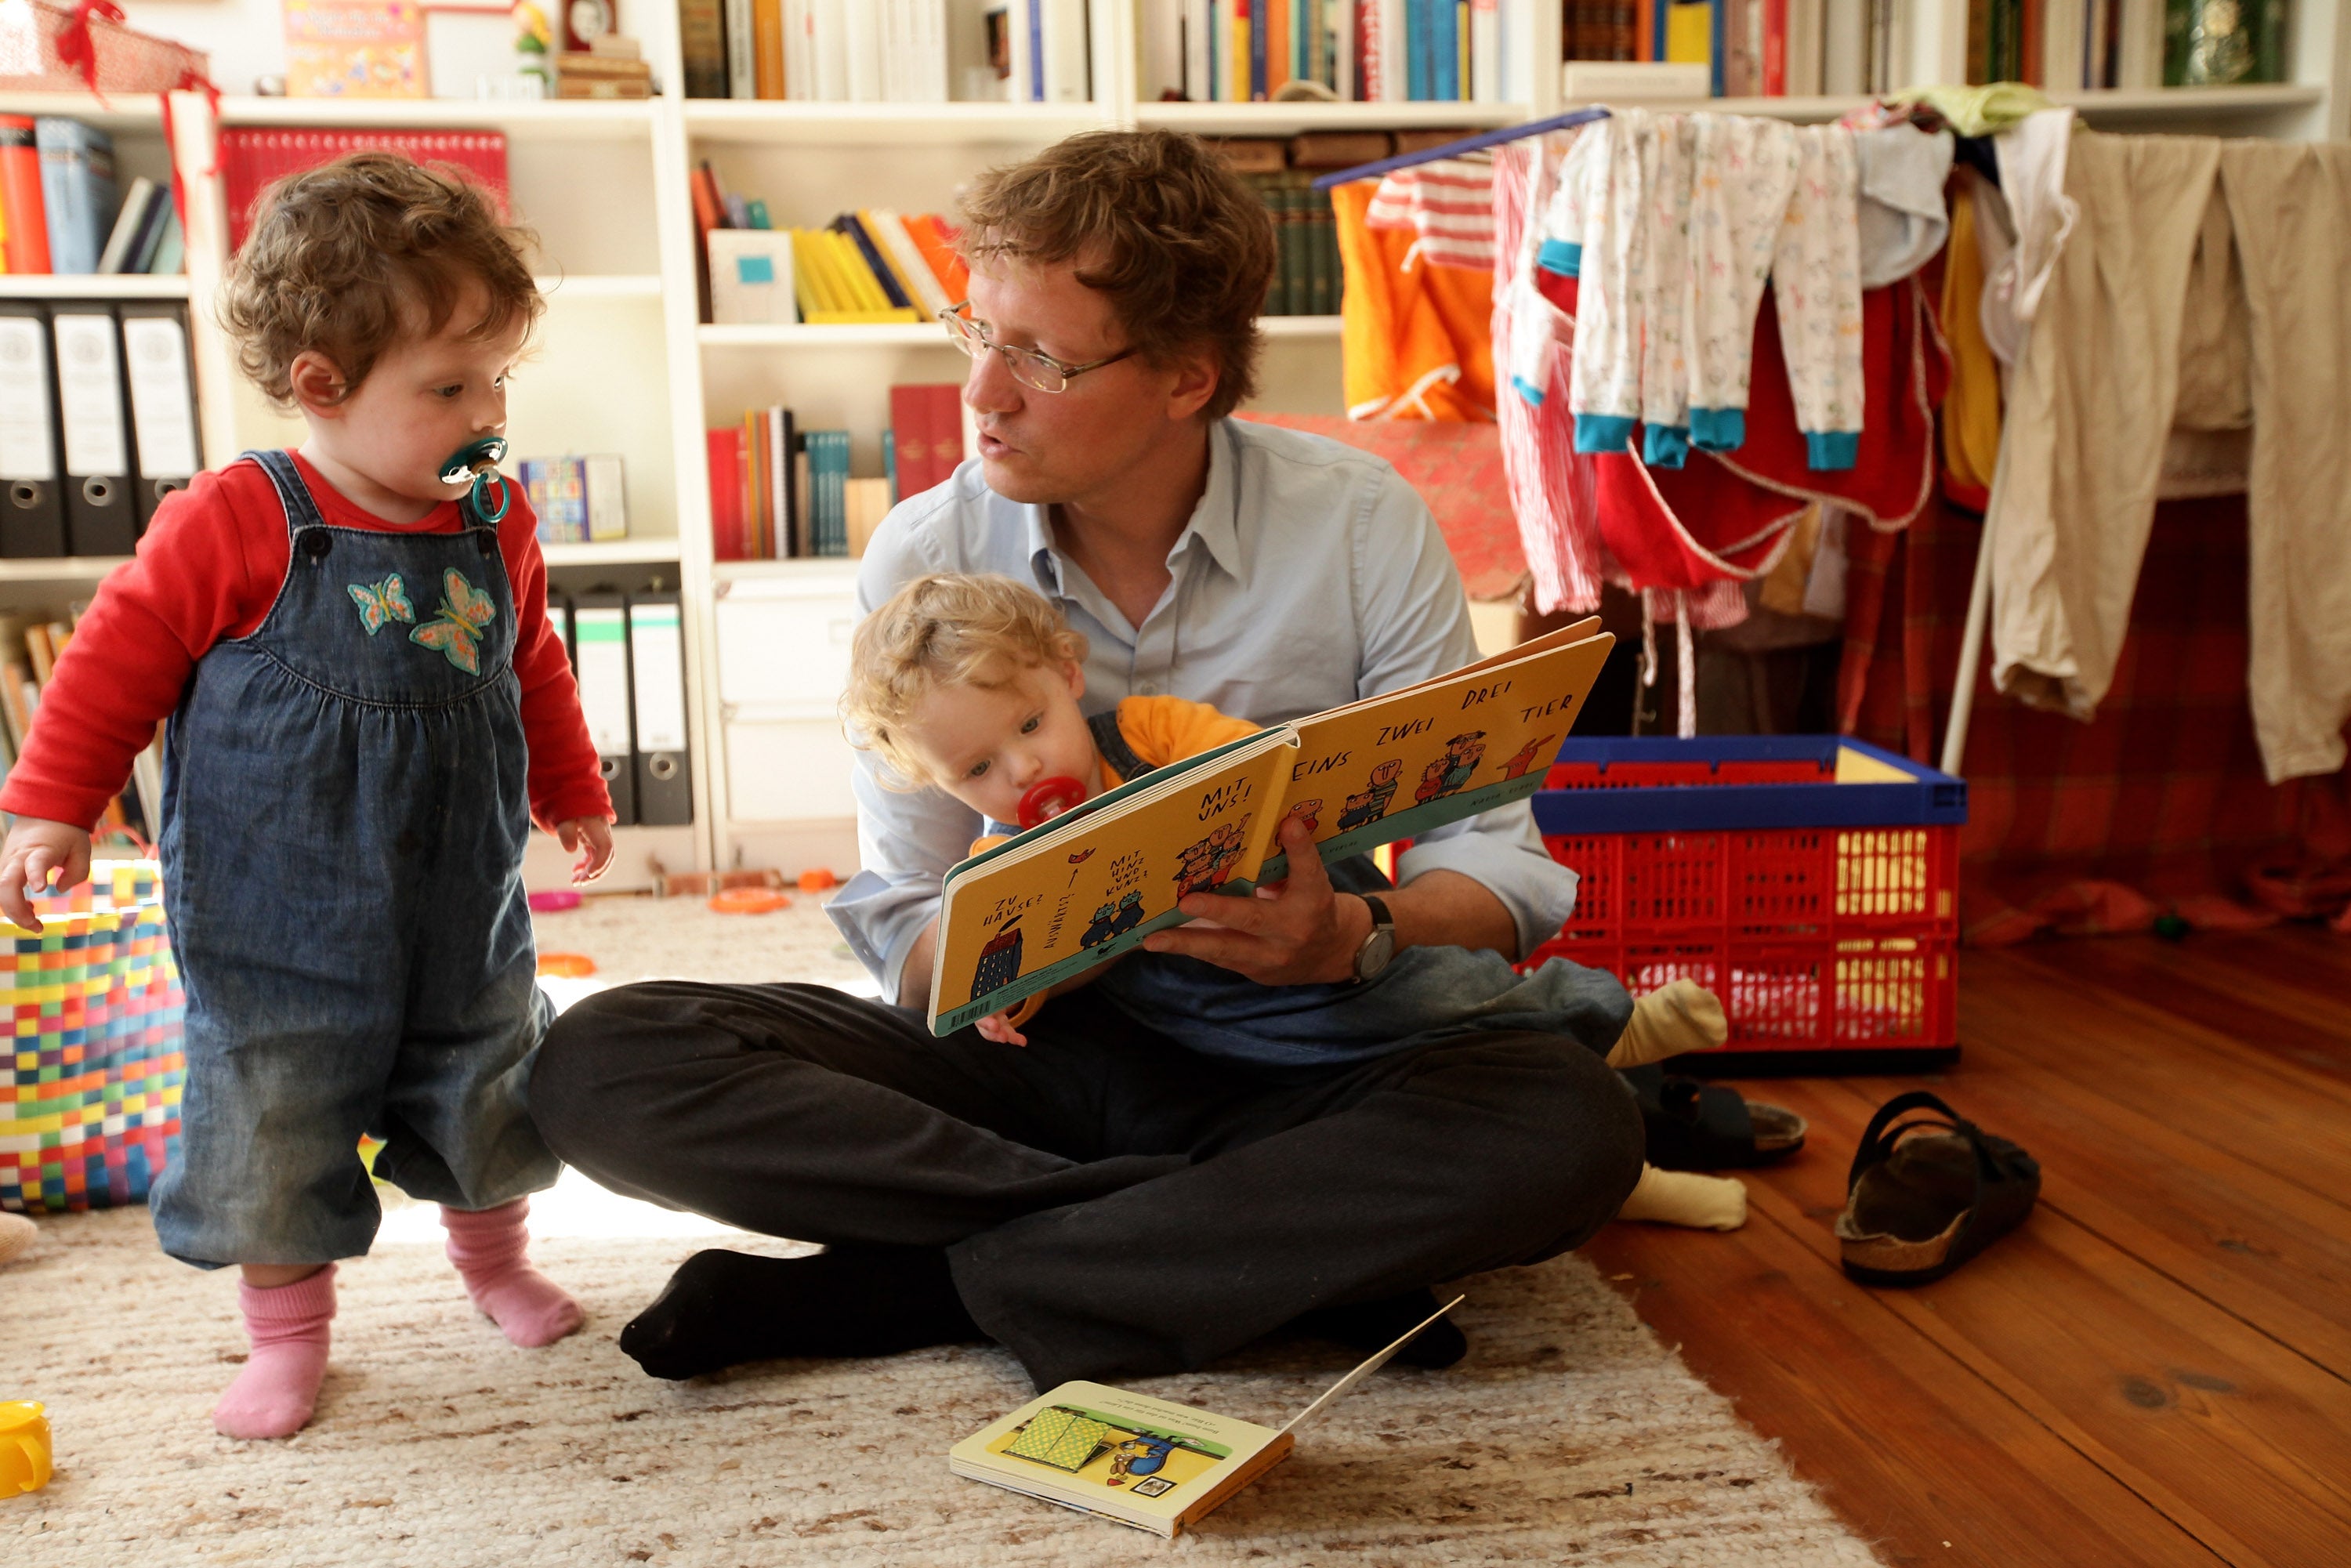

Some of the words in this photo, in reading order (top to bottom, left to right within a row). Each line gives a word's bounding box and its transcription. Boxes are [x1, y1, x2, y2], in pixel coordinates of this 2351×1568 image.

[1462, 680, 1512, 710] DREI
[1521, 694, 1573, 723] TIER
[1376, 717, 1434, 746] ZWEI
[1292, 750, 1353, 782] EINS
[1198, 784, 1252, 821] UNS!
[1201, 777, 1248, 809] MIT
[1110, 849, 1141, 870] MIT
[1112, 857, 1145, 878] HINZ
[1106, 870, 1148, 896] KUNZ?
[1116, 867, 1139, 883] UND
[983, 893, 1044, 926] HAUSE?
[995, 894, 1018, 911] ZU
[1044, 893, 1076, 949] AUSWÄRTS?
